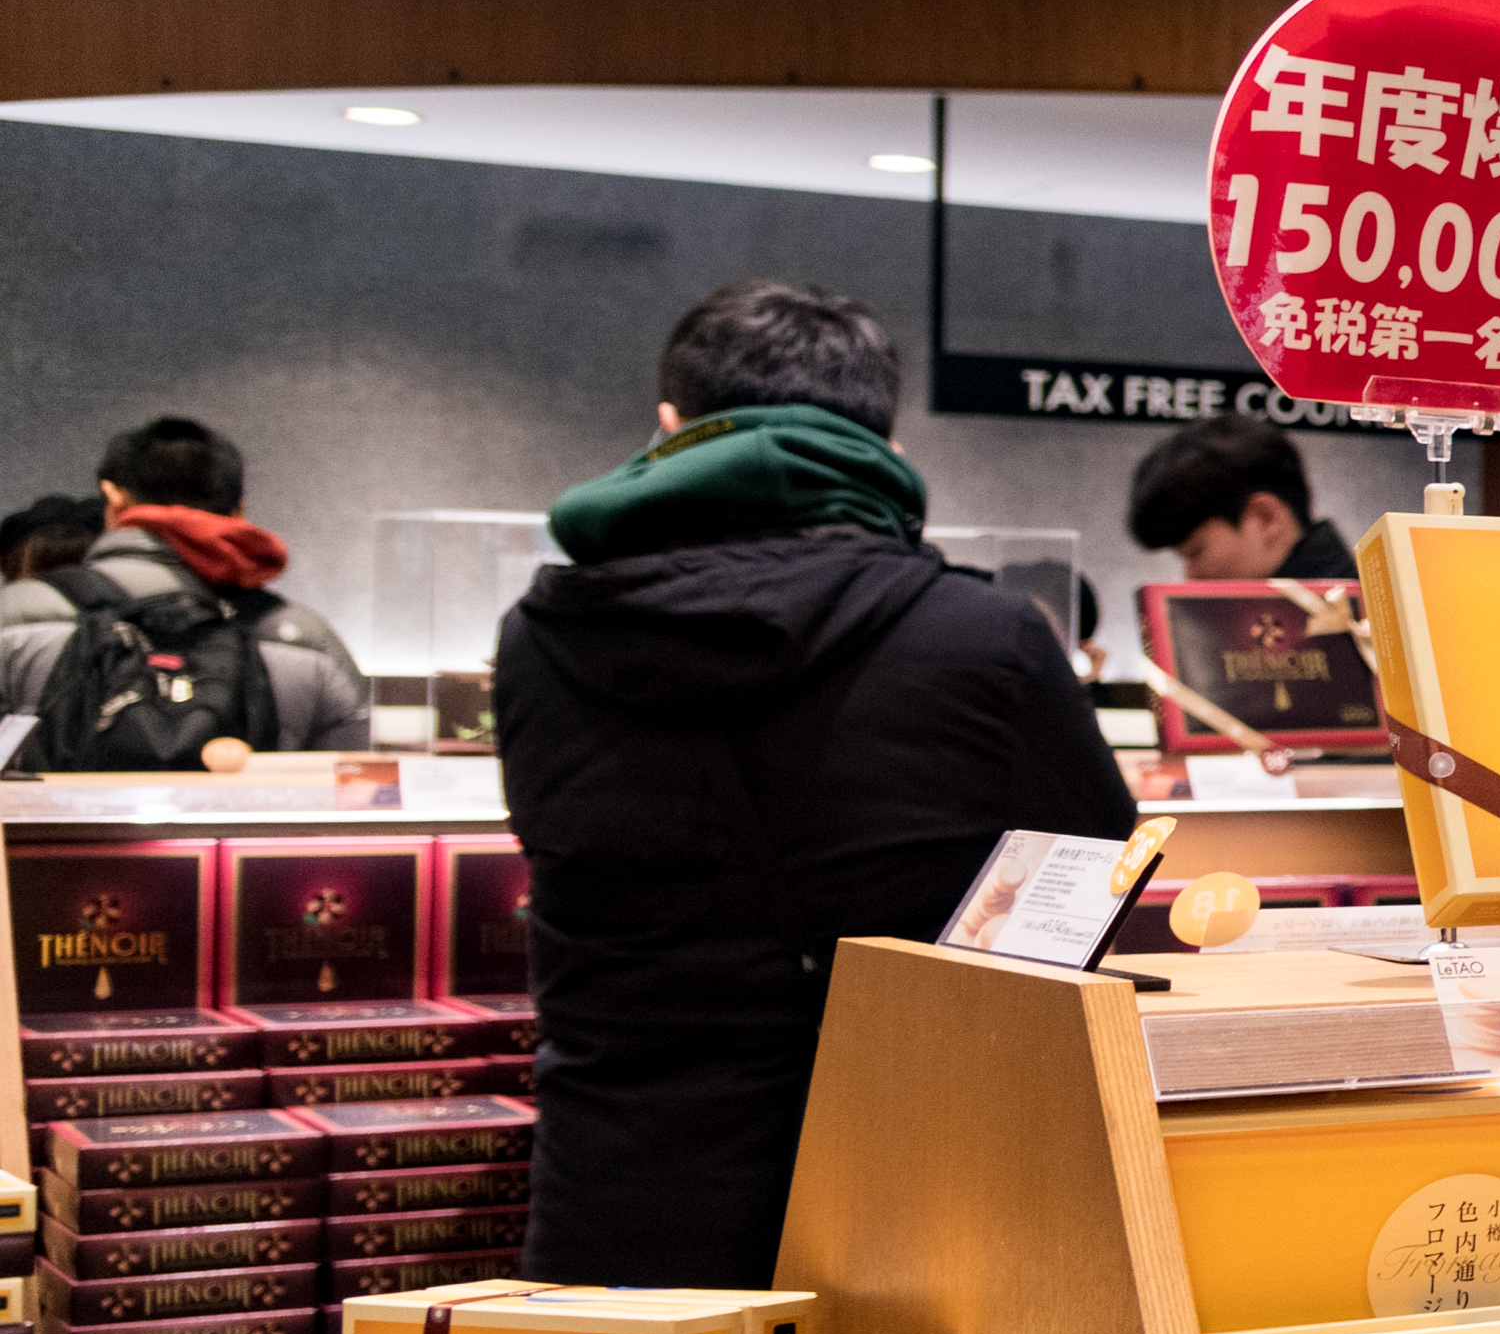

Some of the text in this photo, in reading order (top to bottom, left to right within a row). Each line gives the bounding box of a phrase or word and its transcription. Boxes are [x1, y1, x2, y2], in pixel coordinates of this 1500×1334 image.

[1022, 370, 1111, 415] TAX
[1123, 376, 1226, 420] FREE
[1437, 961, 1484, 975] LeTAO
[1423, 1202, 1447, 1313] フロマージ
[1454, 1201, 1479, 1310] 色内通り
